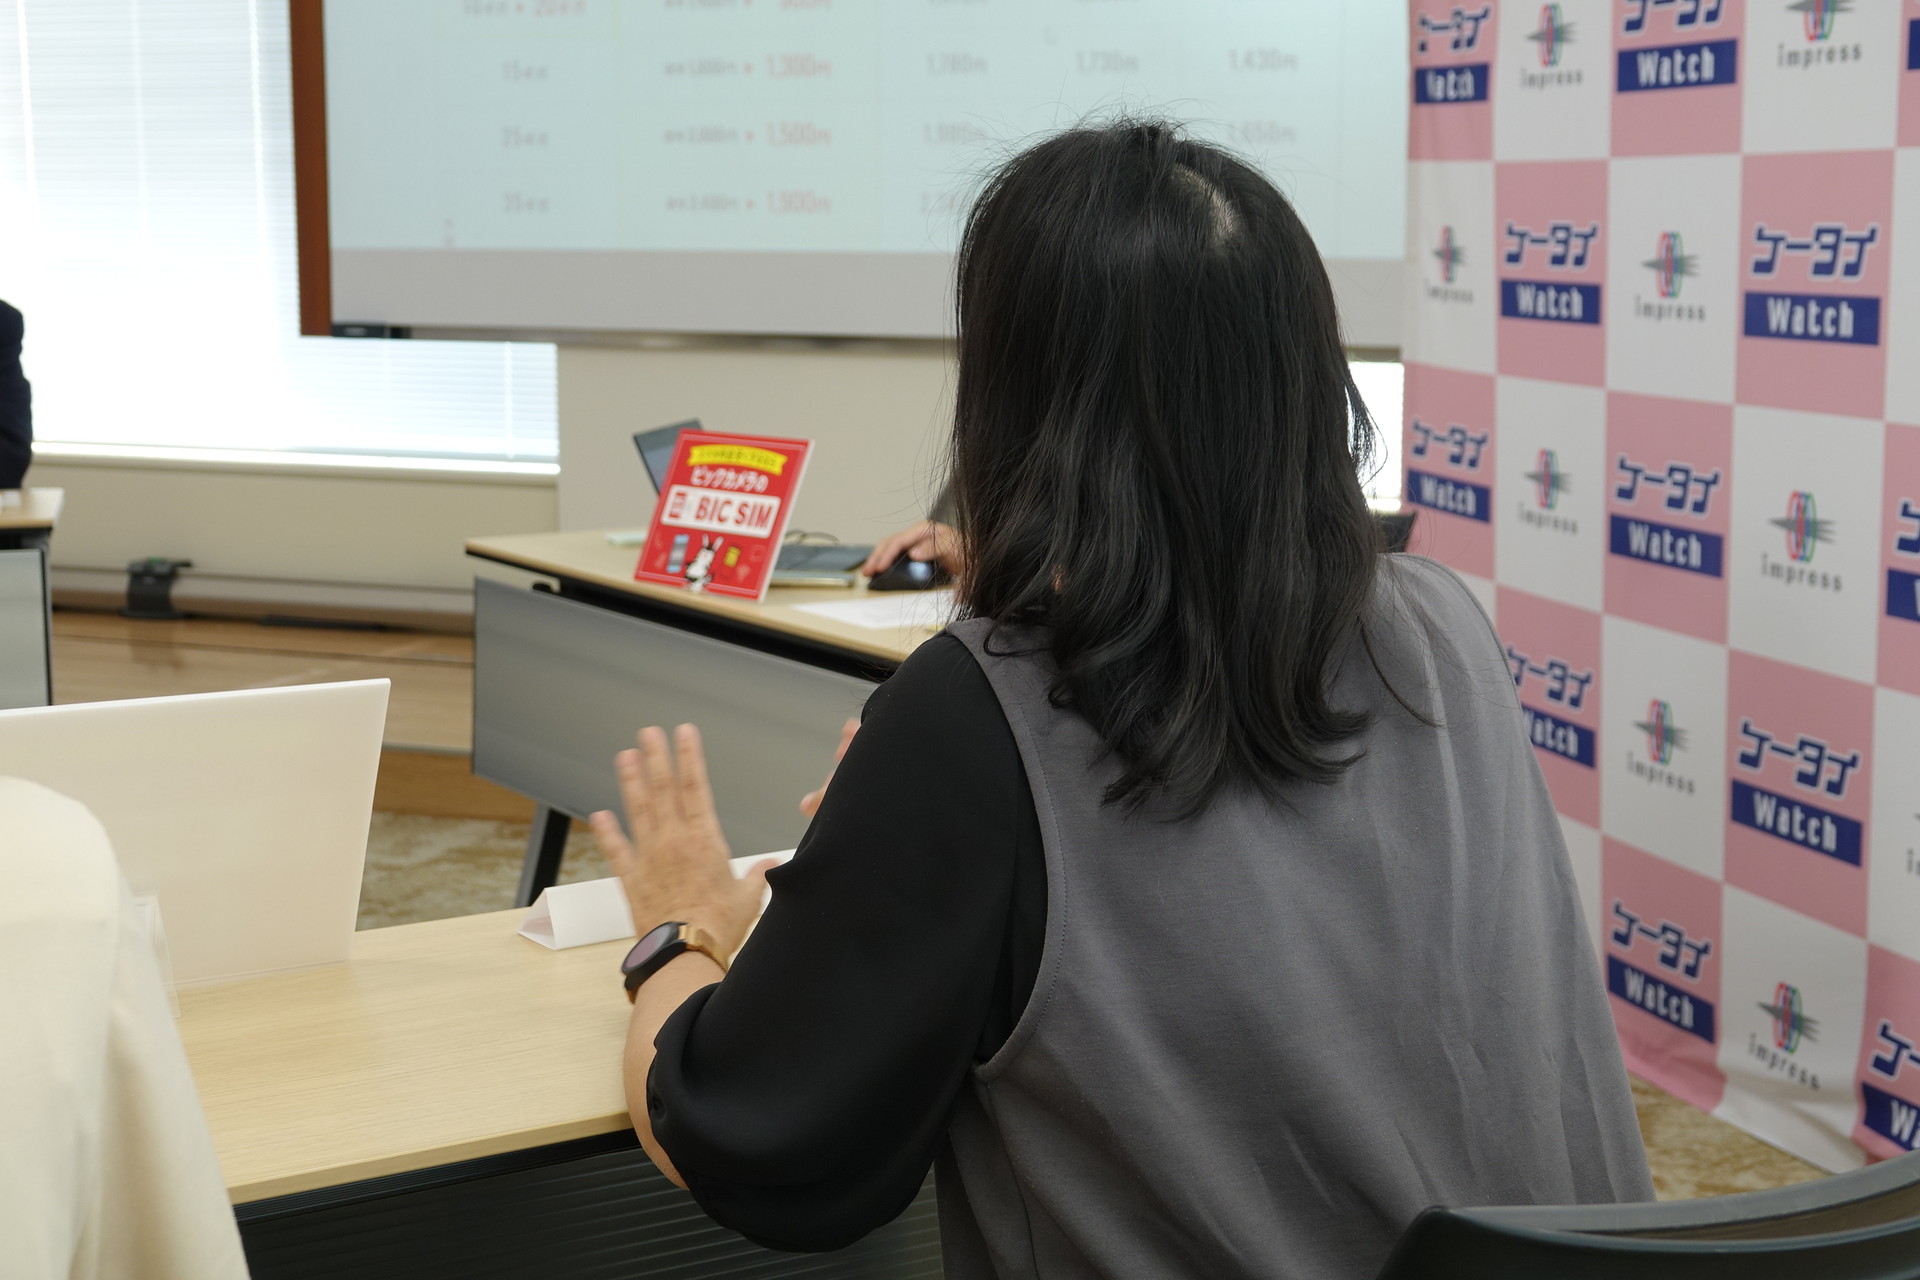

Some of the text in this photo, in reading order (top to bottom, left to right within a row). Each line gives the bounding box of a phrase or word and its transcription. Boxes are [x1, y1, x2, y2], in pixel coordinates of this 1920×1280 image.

[1520, 68, 1583, 89] impress
[1636, 46, 1715, 87] Watch
[1778, 43, 1863, 70] impress
[1504, 223, 1597, 267] ケータイ
[1752, 226, 1878, 277] ケータイ
[1516, 283, 1584, 320] Watch
[1633, 294, 1707, 323] impress
[1766, 296, 1854, 338] Watch
[1411, 420, 1488, 469] ケータイ
[1418, 475, 1477, 516] Watch
[1616, 455, 1720, 514] ケータイ
[695, 495, 733, 523] BIC
[735, 501, 773, 528] SIM
[1517, 502, 1579, 535] impress
[1627, 521, 1702, 570] Watch
[1760, 552, 1843, 593] impress
[1626, 751, 1696, 796] impress
[1738, 720, 1860, 796] ケータイ
[1753, 790, 1838, 852] Watch
[1612, 901, 1712, 978] ケータイ
[1623, 967, 1695, 1030] Watch
[1748, 1032, 1821, 1092] impress
